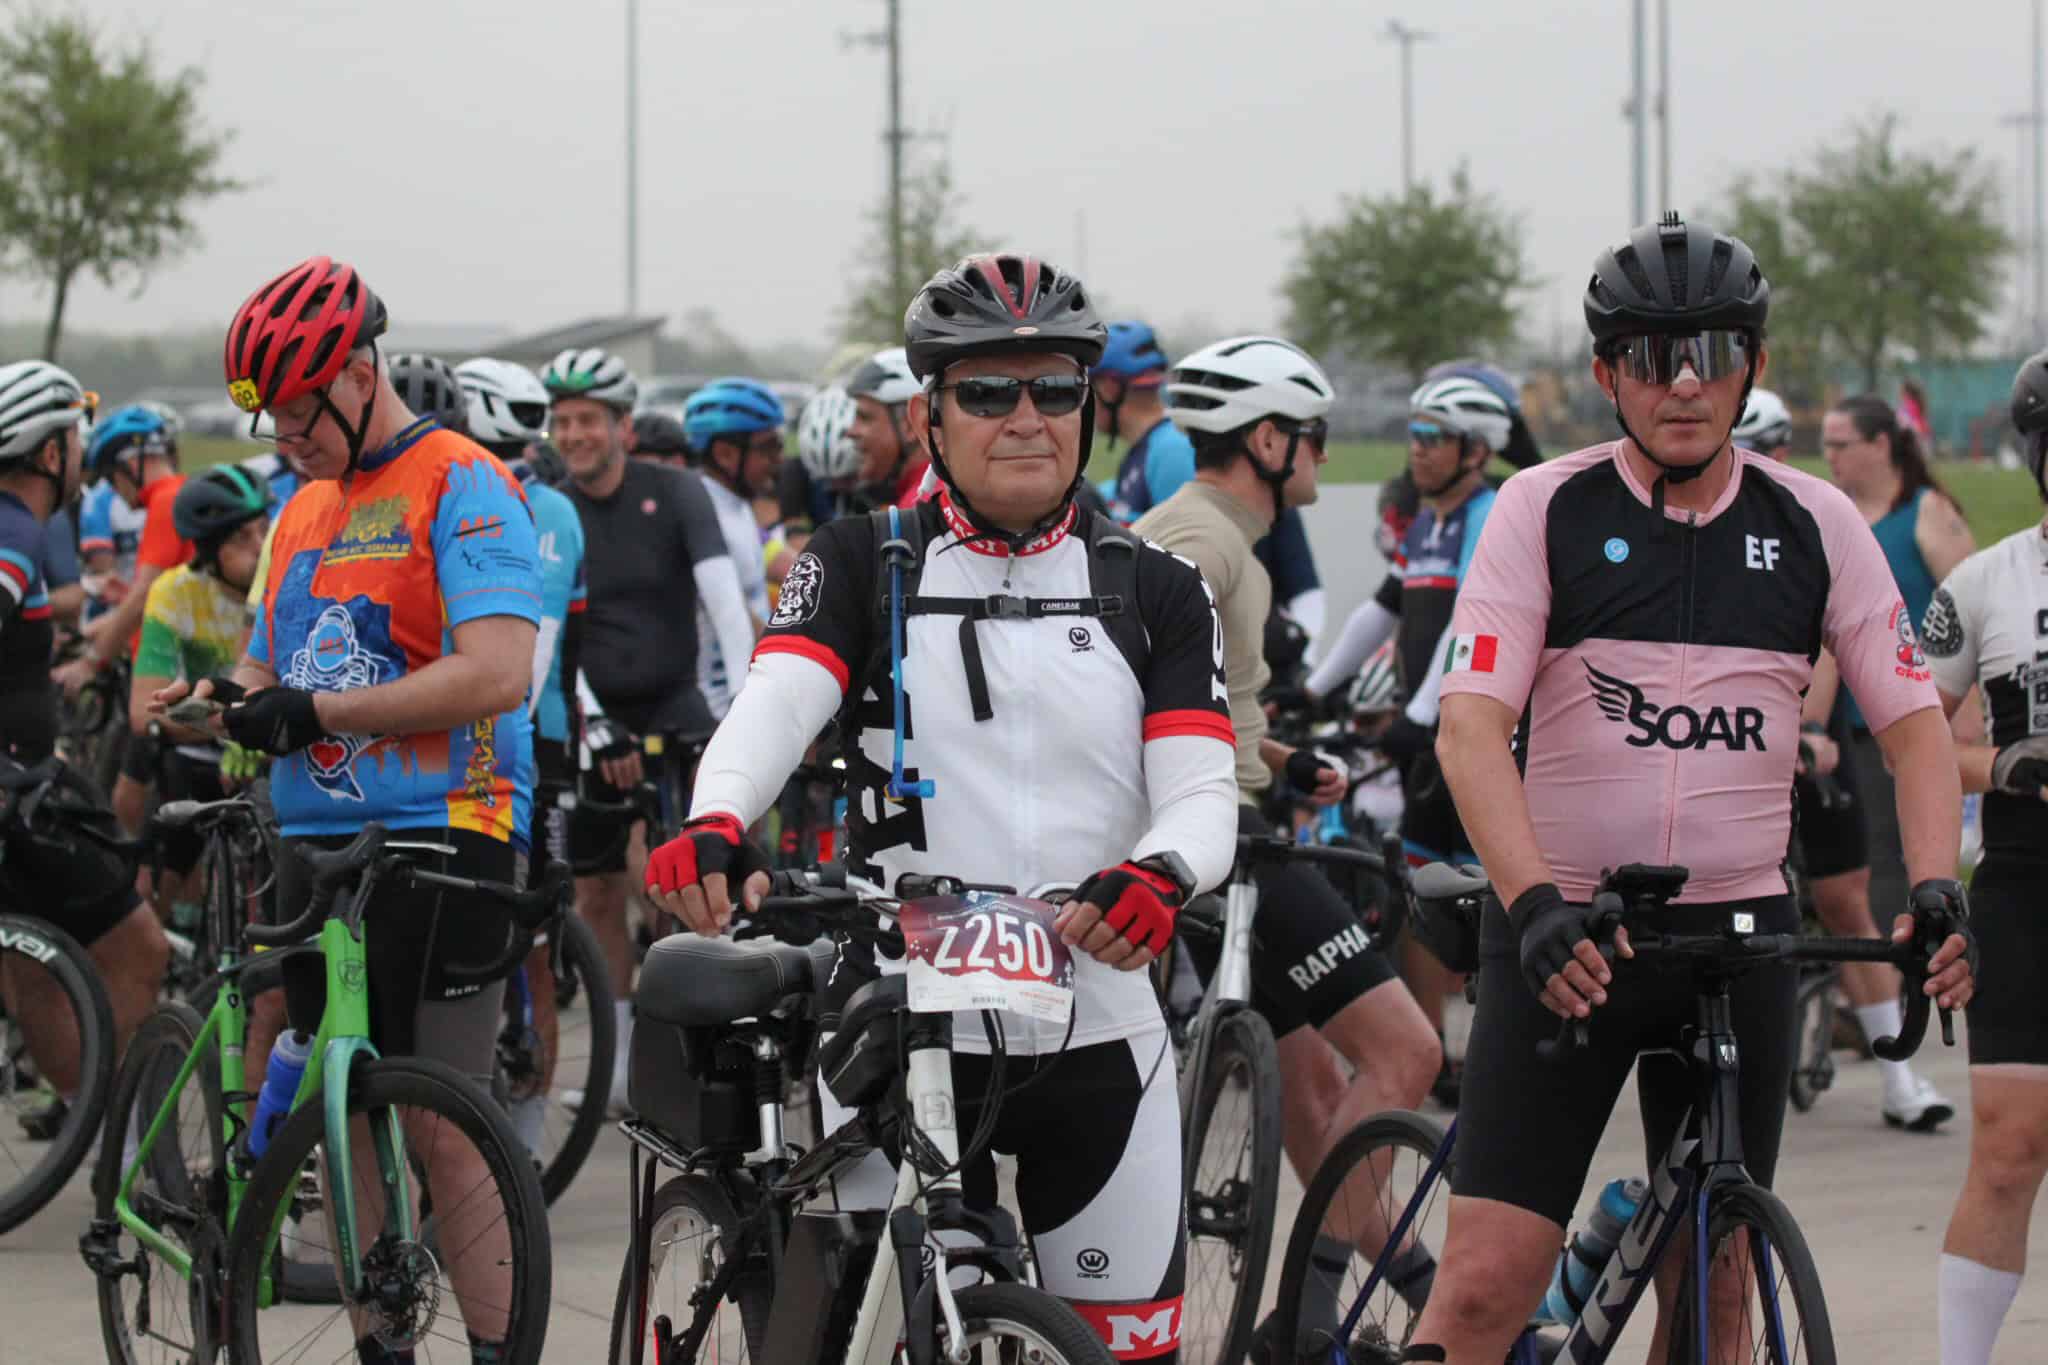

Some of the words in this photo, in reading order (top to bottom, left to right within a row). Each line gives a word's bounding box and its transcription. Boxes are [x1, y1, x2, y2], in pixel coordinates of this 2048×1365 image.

[1745, 534, 1780, 571] EF
[1624, 701, 1768, 752] SOAR
[1287, 923, 1371, 991] RAPHA
